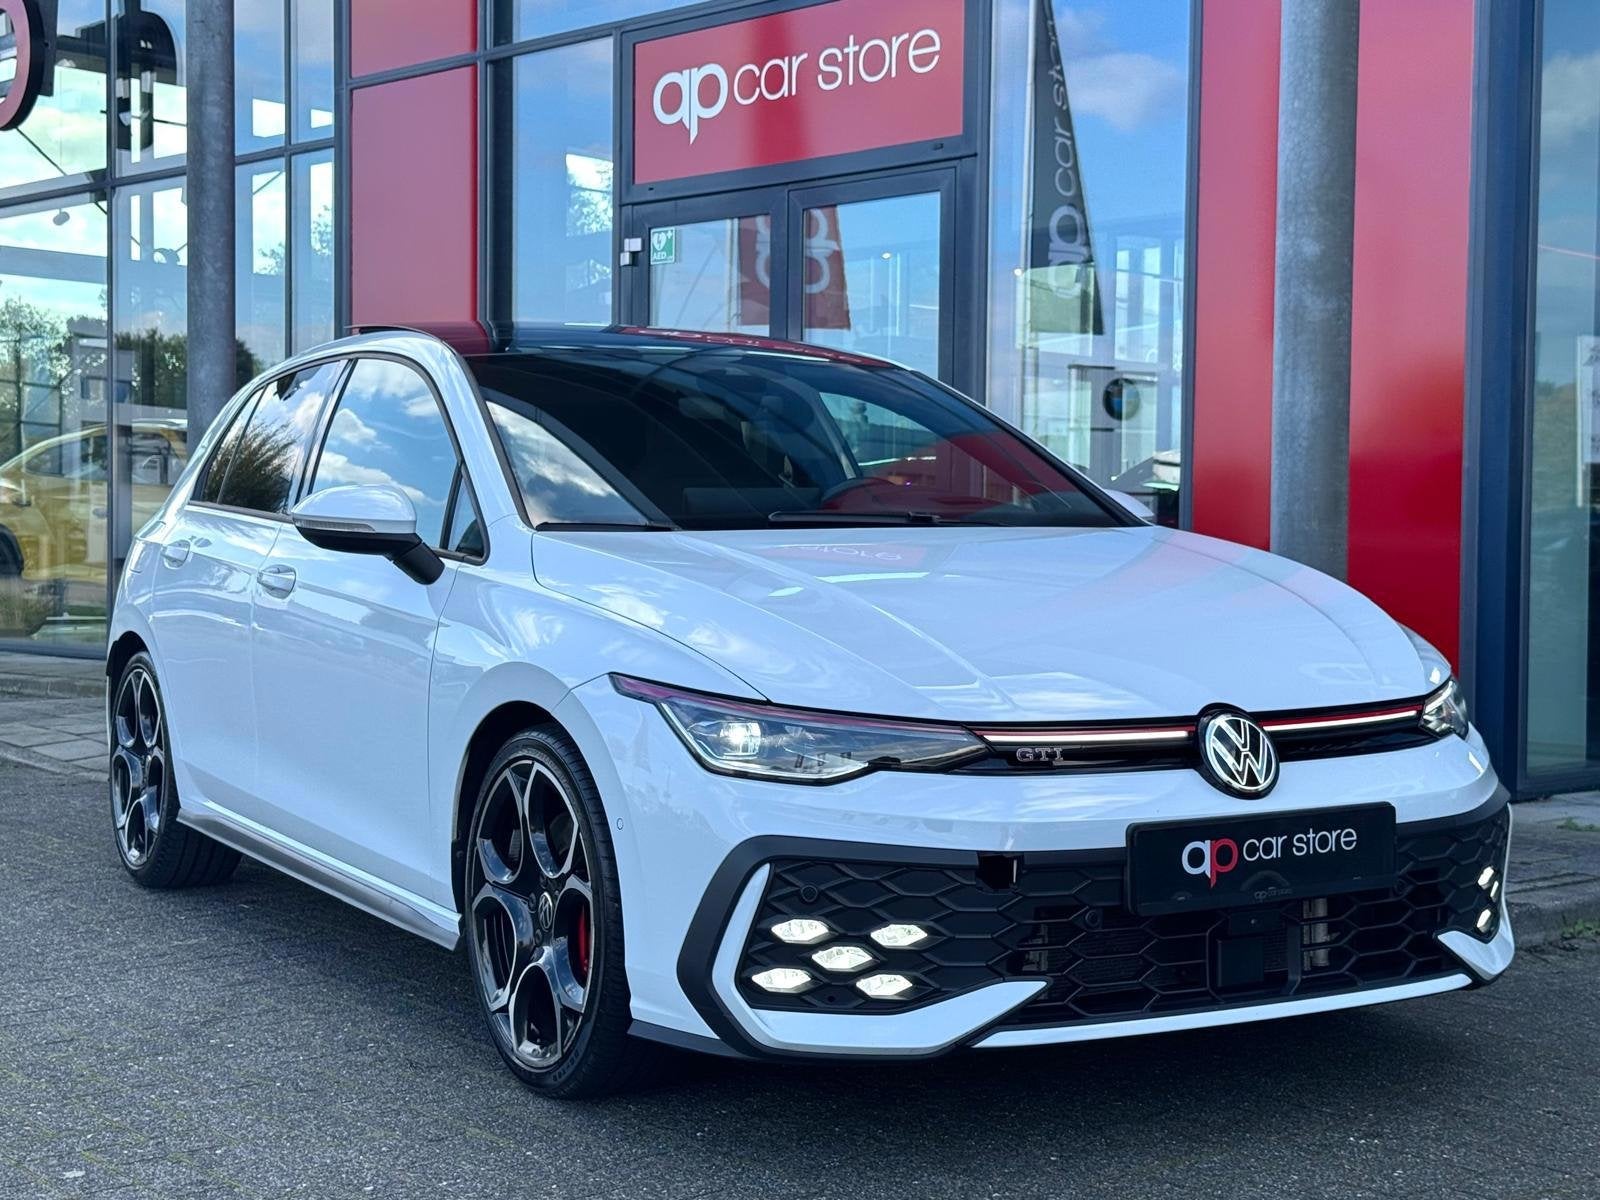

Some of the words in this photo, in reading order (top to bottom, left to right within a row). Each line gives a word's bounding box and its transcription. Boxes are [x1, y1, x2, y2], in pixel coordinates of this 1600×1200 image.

[652, 62, 729, 145] ap
[733, 52, 808, 106] car
[816, 28, 941, 92] store
[1054, 116, 1077, 197] car
[653, 251, 667, 260] AED
[1016, 746, 1064, 763] GTI
[1181, 838, 1239, 889] ap
[1242, 834, 1288, 862] car
[1292, 827, 1358, 857] store
